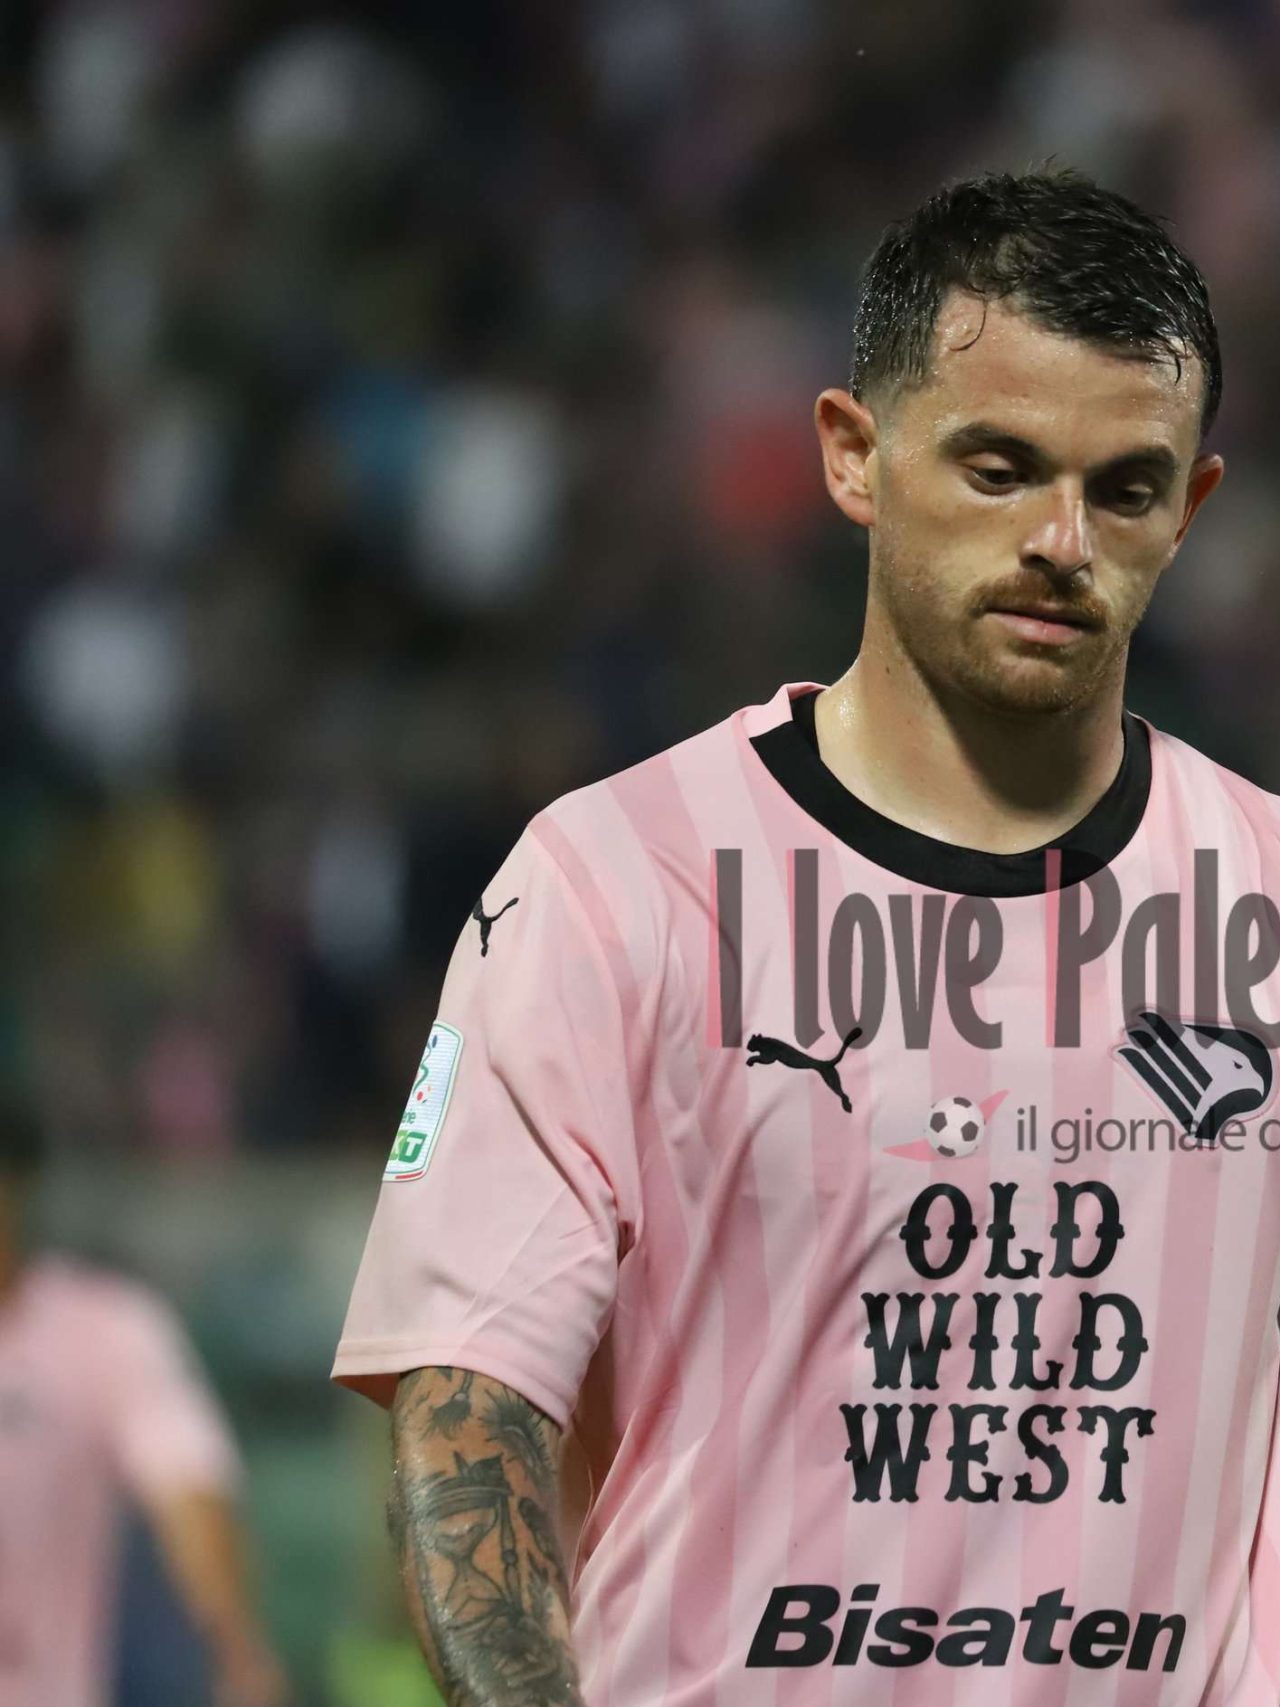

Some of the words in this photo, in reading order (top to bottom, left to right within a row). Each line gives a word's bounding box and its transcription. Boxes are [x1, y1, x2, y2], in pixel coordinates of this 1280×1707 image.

[899, 1180, 1125, 1280] OLD
[860, 1292, 1149, 1392] WILD
[838, 1402, 1157, 1504] WEST
[744, 1583, 1187, 1673] Bisaten
